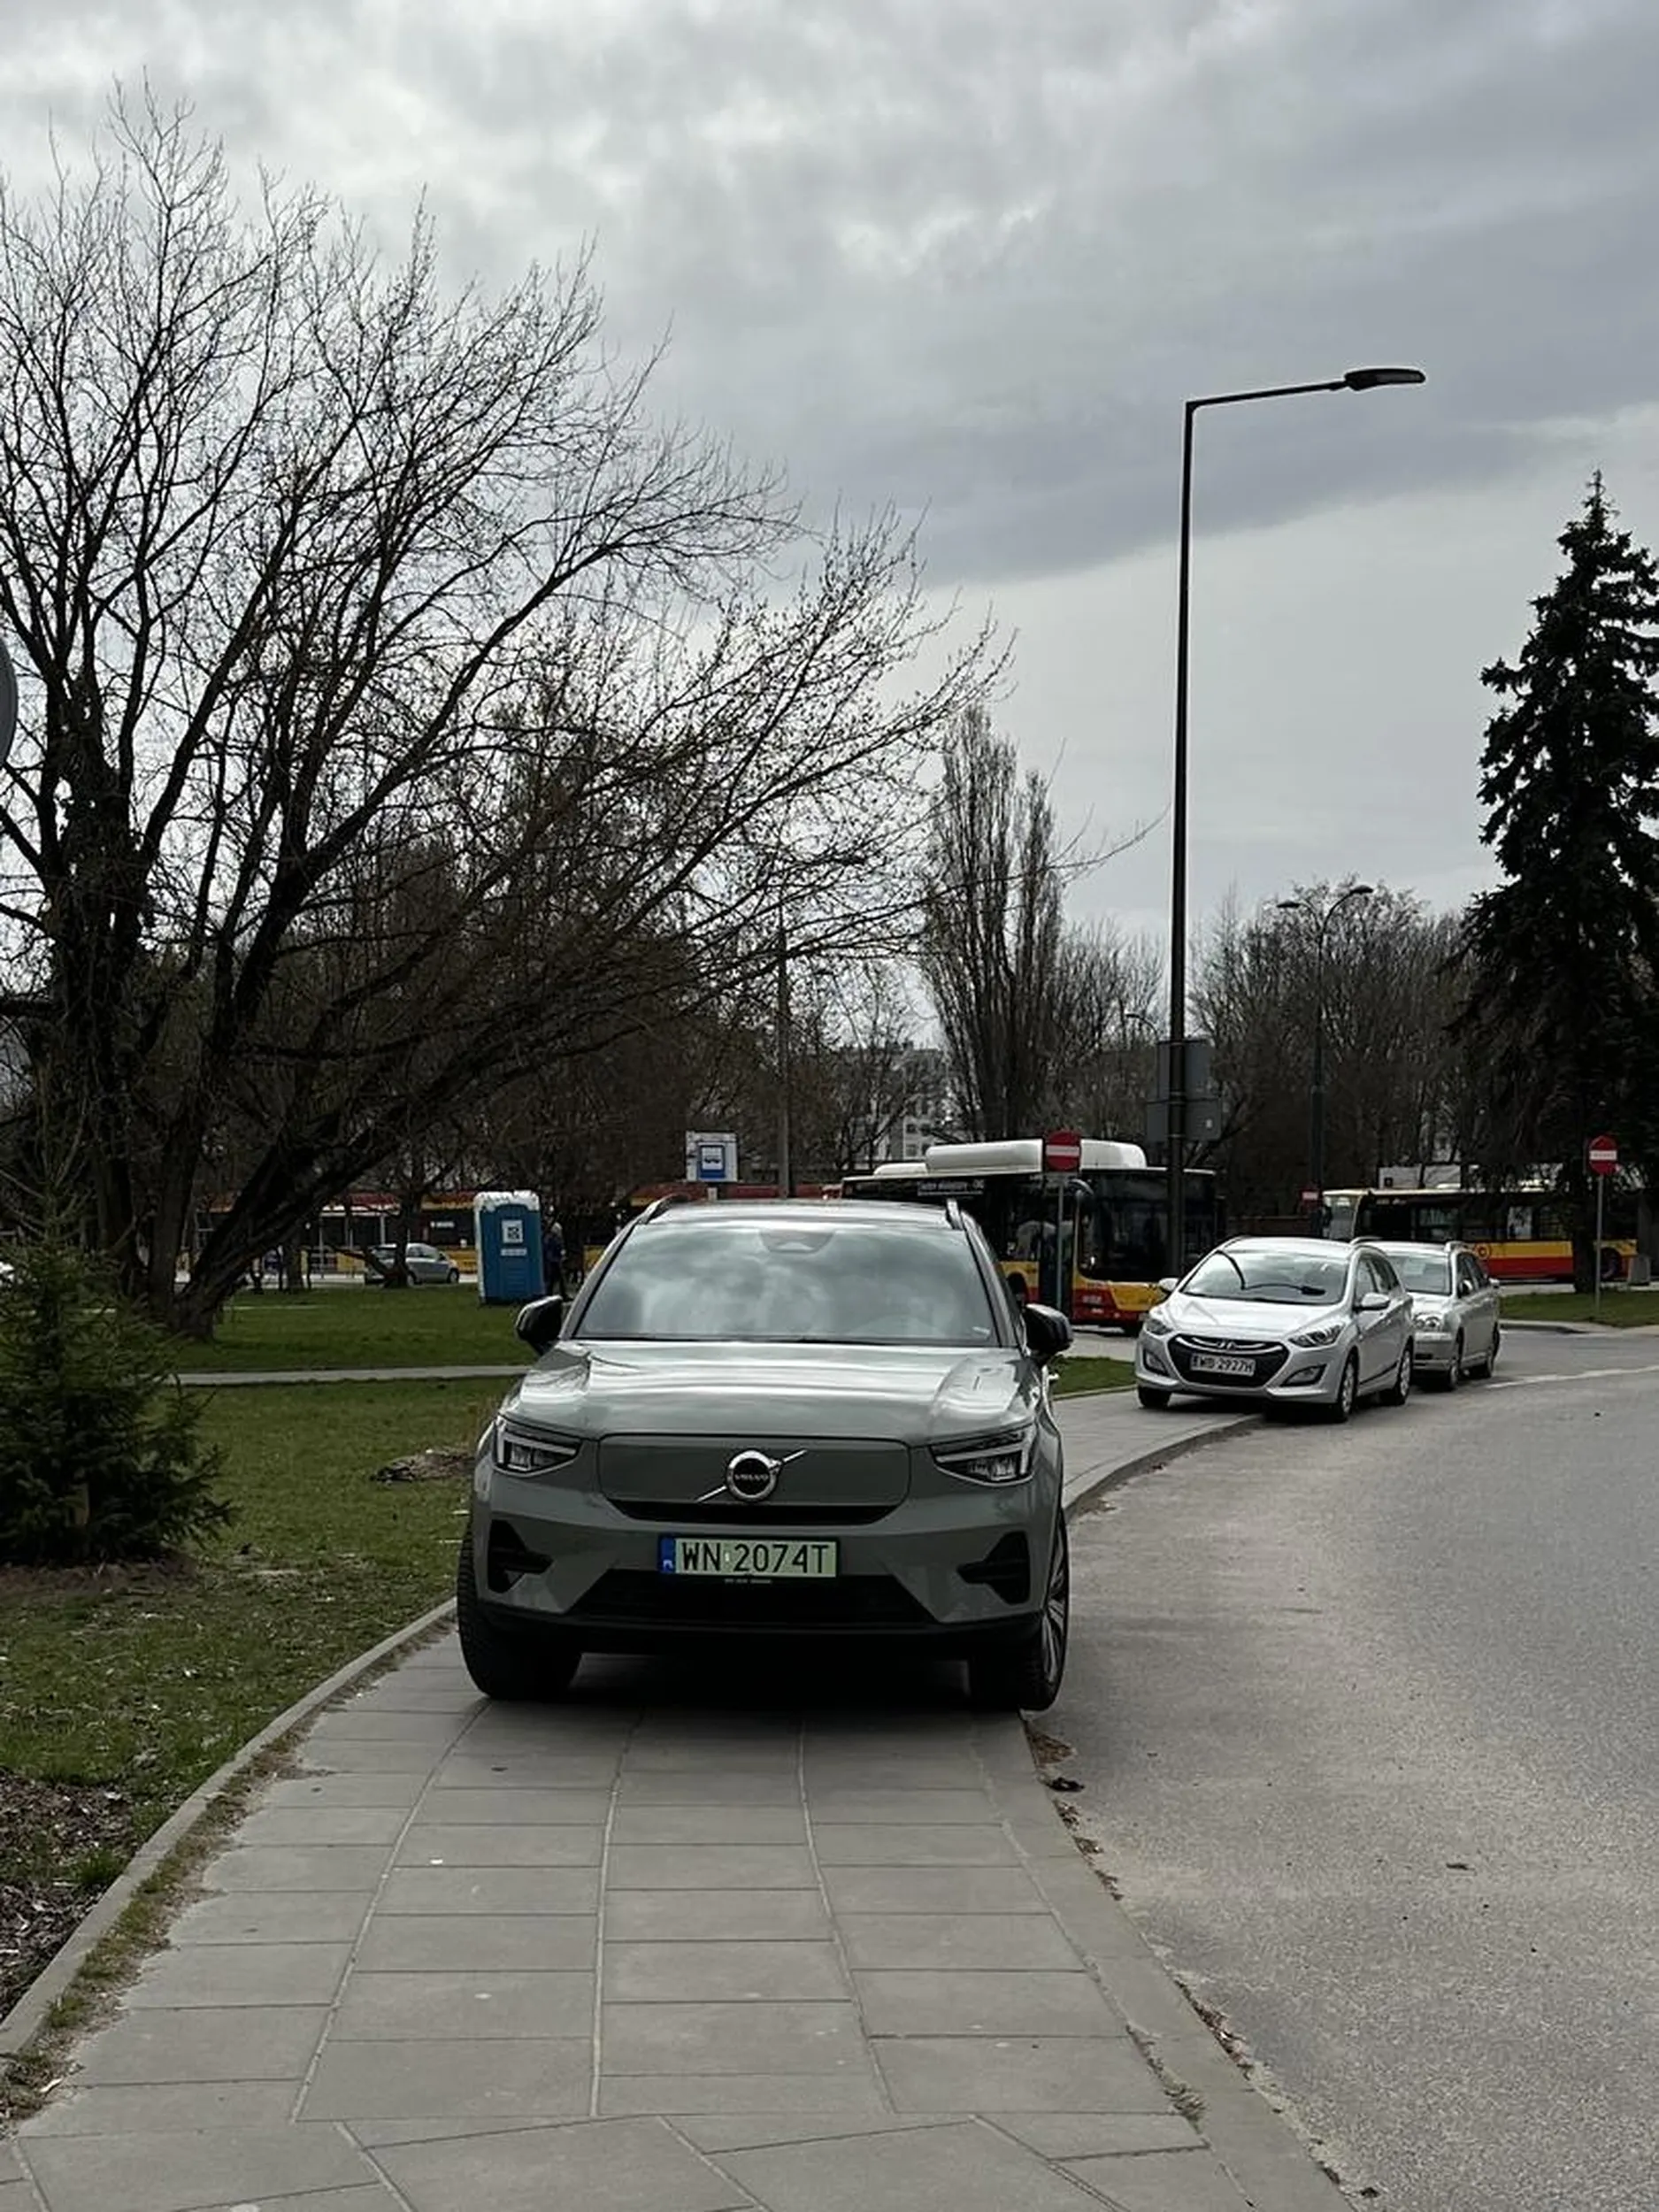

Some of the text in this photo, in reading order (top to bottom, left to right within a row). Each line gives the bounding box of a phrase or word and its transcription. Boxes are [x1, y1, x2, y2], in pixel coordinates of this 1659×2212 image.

[733, 1473, 769, 1482] VOLVO
[682, 1542, 829, 1574] WN 2074T
